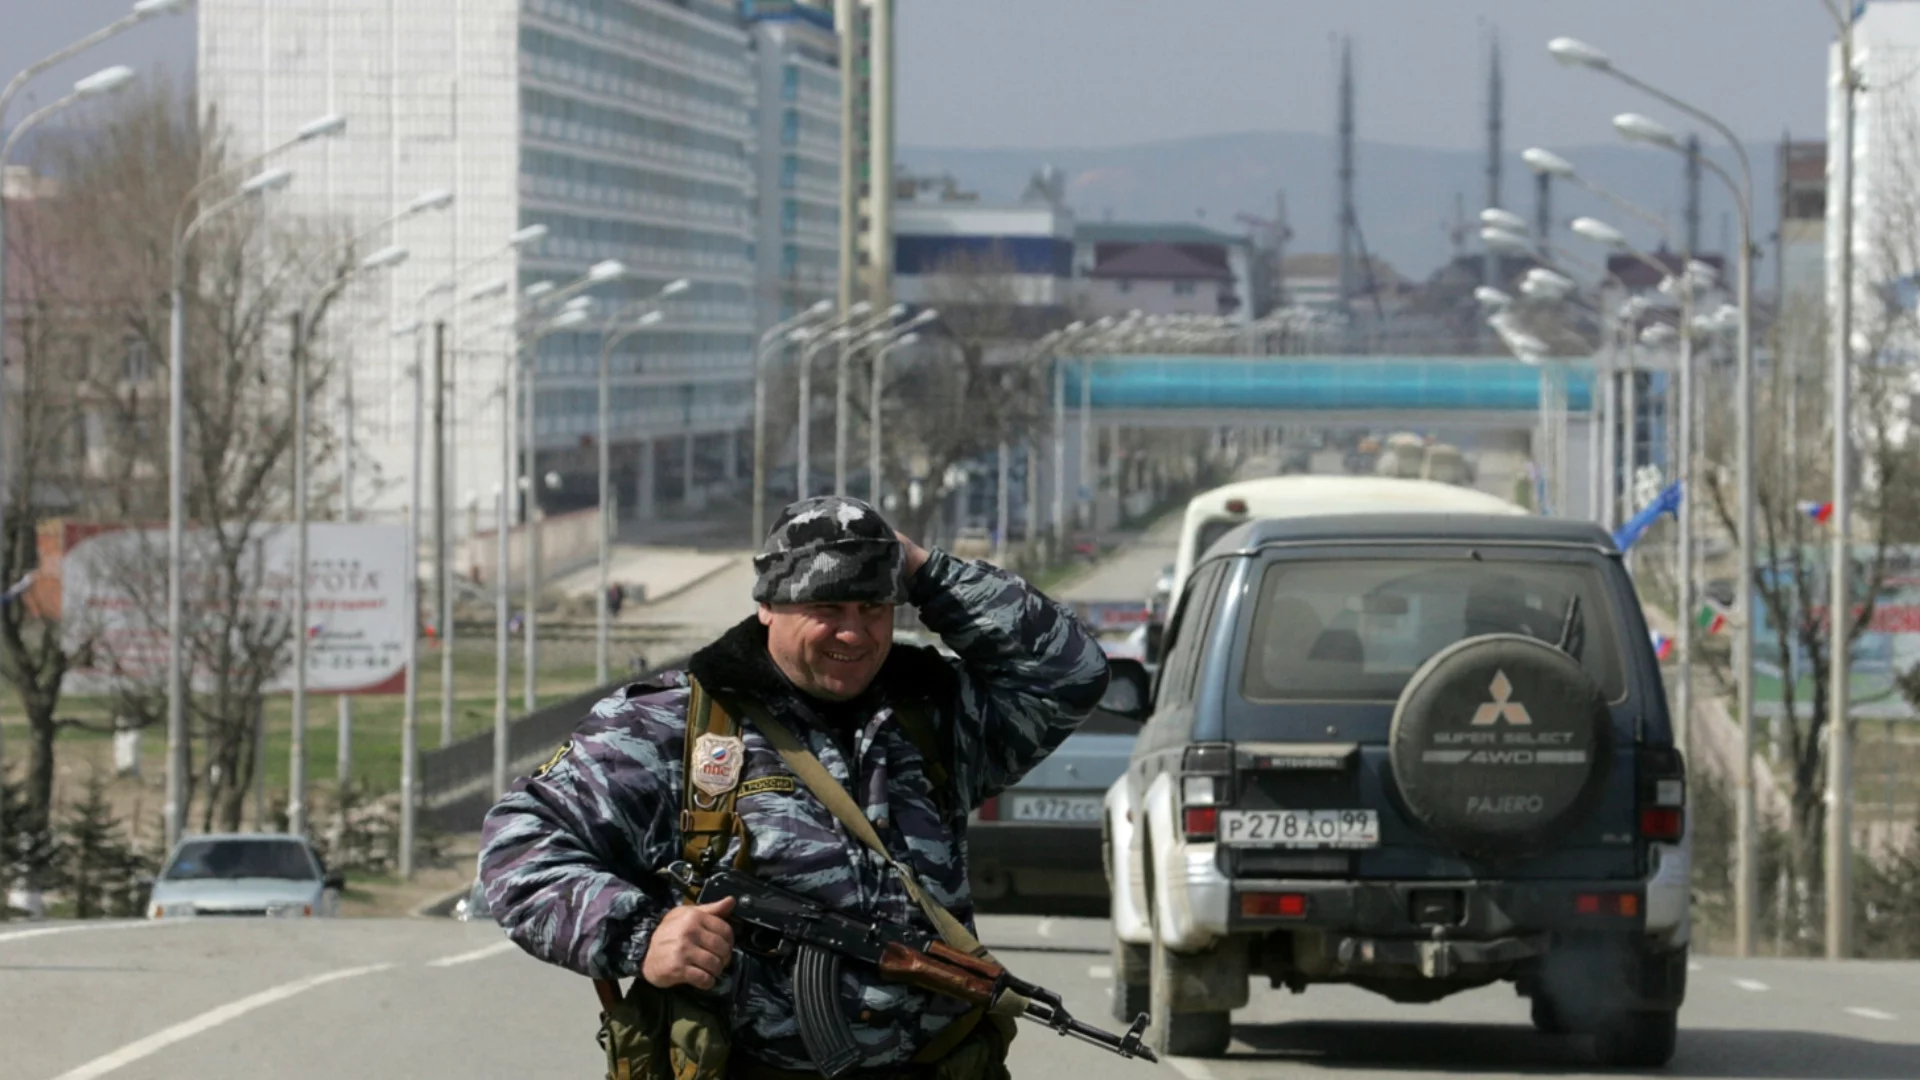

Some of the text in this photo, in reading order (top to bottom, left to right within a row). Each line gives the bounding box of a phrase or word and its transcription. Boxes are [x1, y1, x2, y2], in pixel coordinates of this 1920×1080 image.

[1433, 732, 1574, 744] SUPER SELECT
[1469, 751, 1533, 763] 4WD
[1466, 795, 1544, 814] PAJERO
